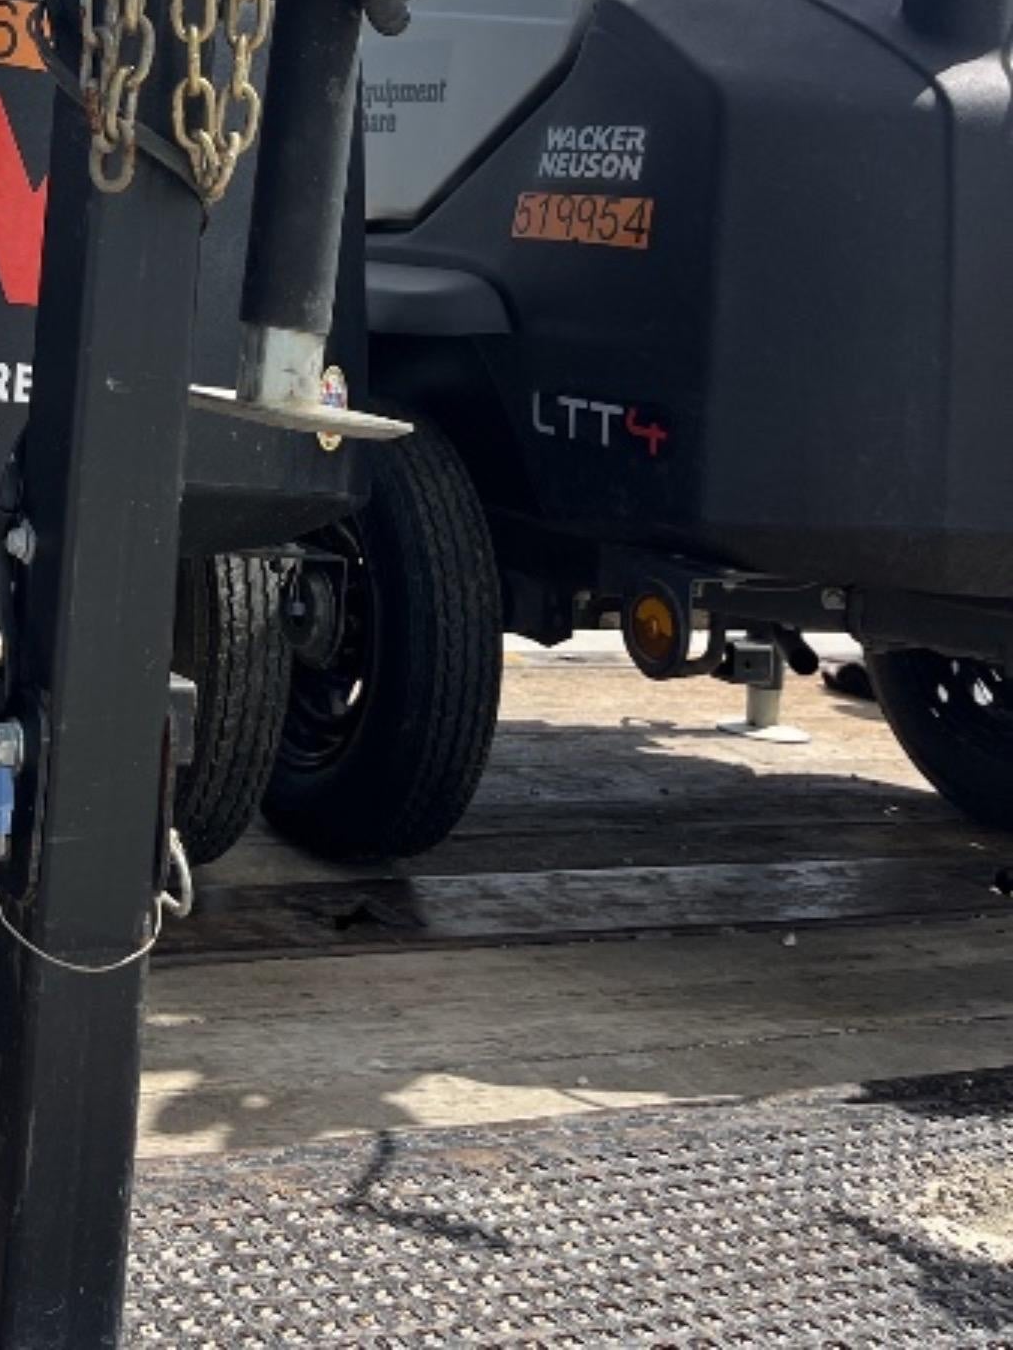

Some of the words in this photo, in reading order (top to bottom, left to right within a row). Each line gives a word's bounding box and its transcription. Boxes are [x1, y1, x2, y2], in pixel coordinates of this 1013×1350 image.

[361, 76, 448, 109] quipment
[546, 124, 647, 153] WACKER
[539, 152, 645, 181] NEUSON
[514, 193, 646, 243] 519954
[531, 389, 669, 456] LTT4
